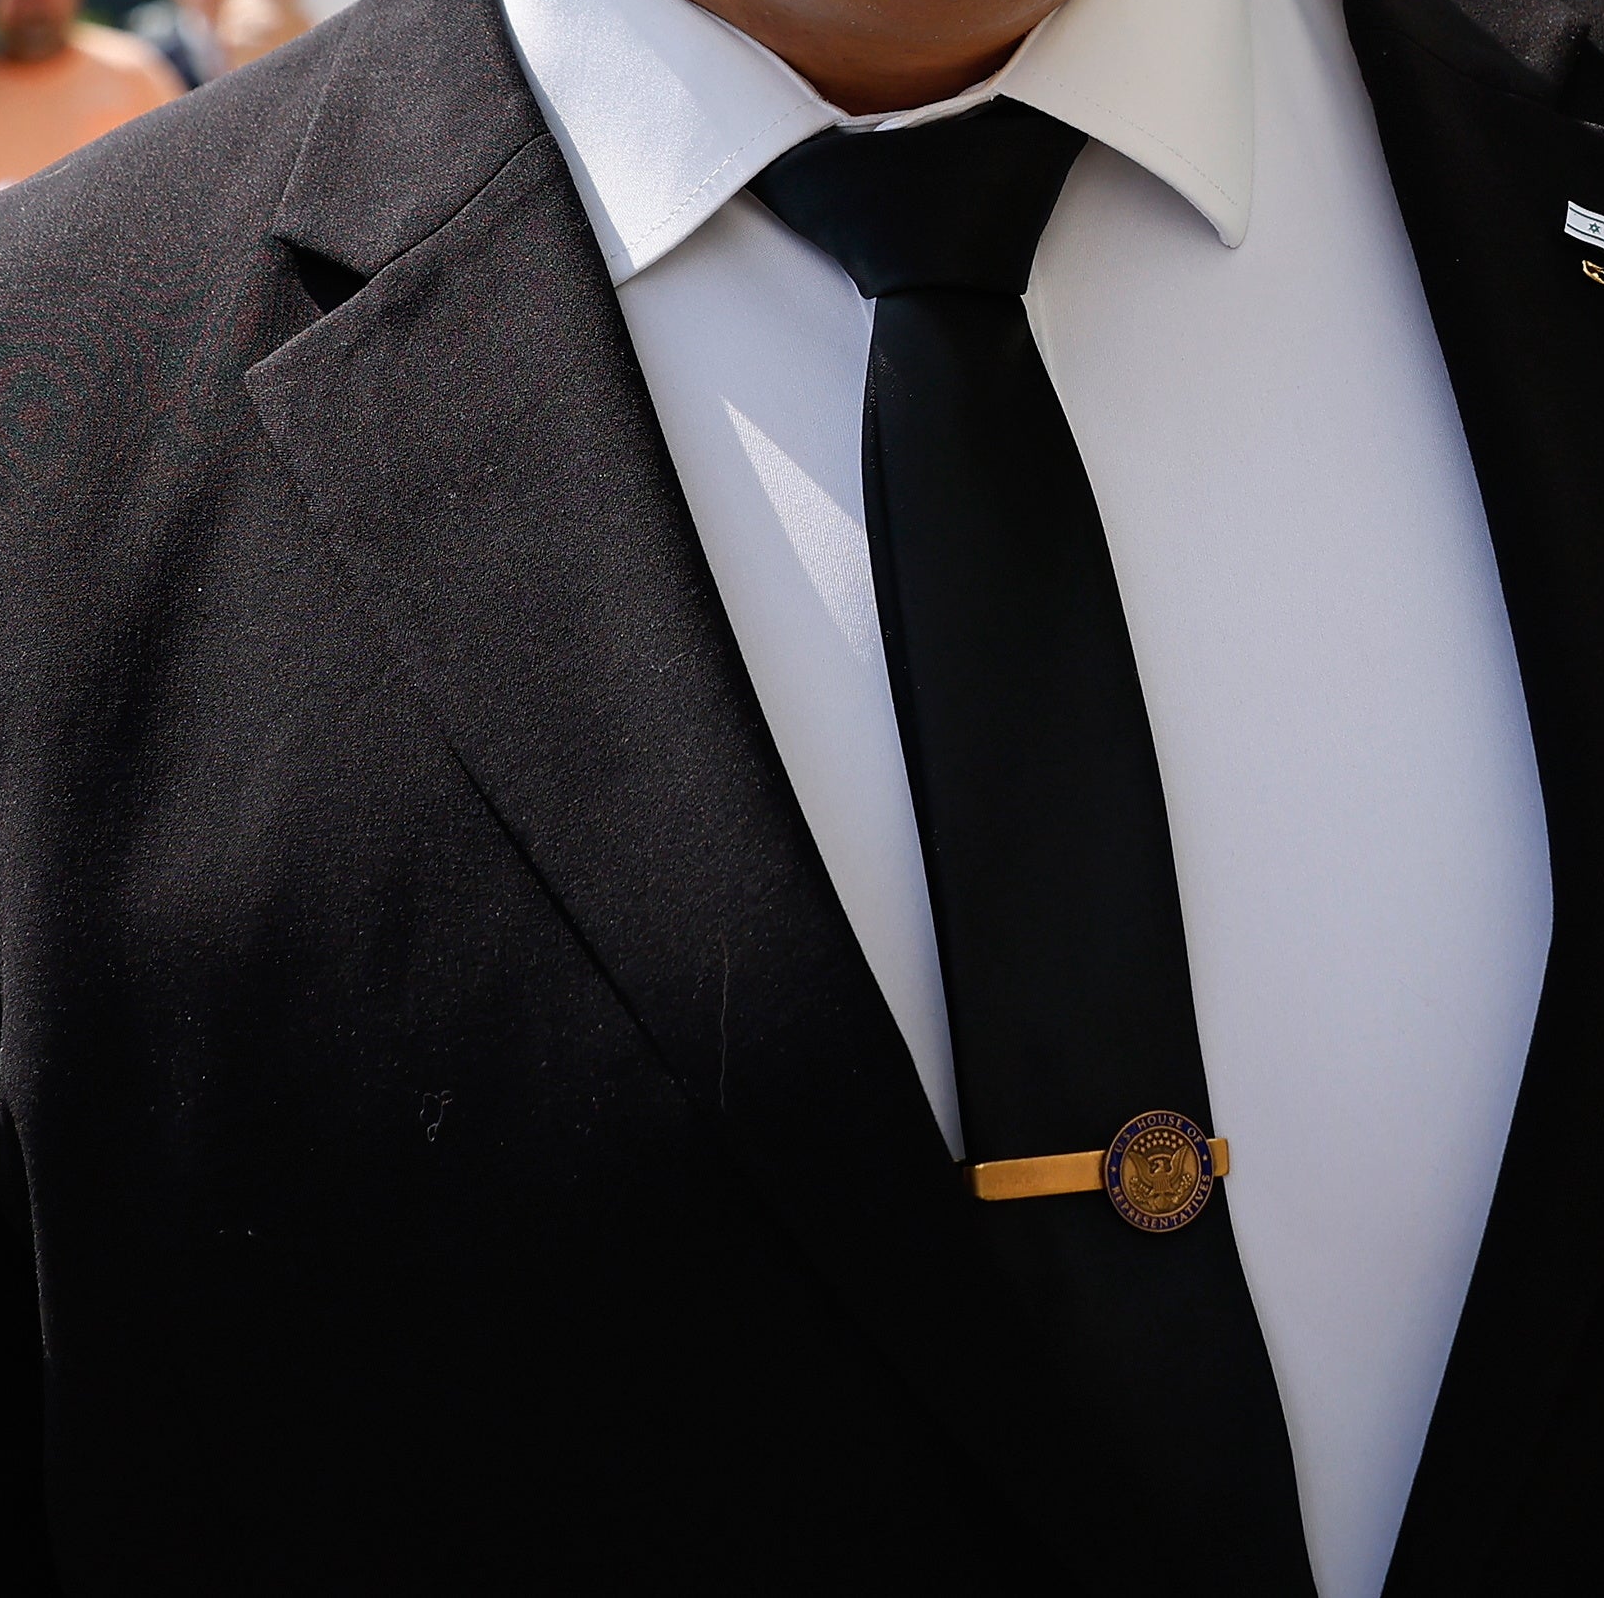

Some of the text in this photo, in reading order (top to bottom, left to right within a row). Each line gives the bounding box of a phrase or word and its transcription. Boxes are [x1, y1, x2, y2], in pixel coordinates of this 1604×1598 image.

[1137, 1114, 1184, 1130] HOUSE
[1187, 1128, 1203, 1143] OF
[1111, 1174, 1211, 1228] REPRESENTATIVES
